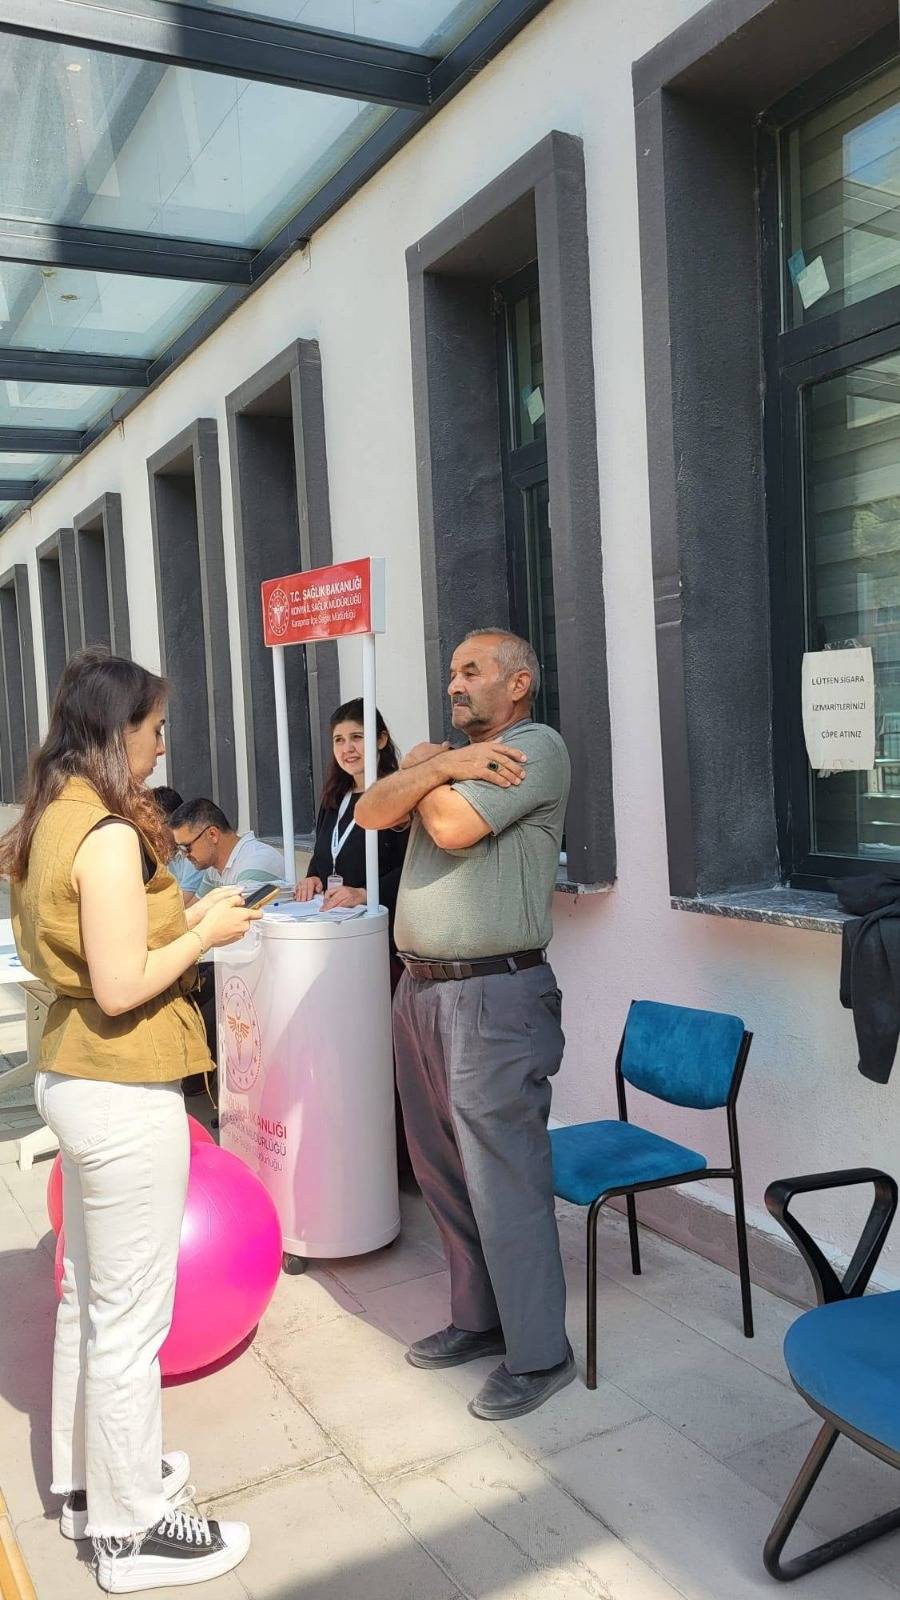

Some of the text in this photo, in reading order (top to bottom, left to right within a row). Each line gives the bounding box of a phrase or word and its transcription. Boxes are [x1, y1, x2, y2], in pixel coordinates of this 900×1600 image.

[289, 576, 362, 602] T.C. SAĞLIK BAKANLIĞI
[811, 674, 865, 686] LÜTFEN SİGARA
[821, 729, 862, 740] ÇÖPE ATINIZ
